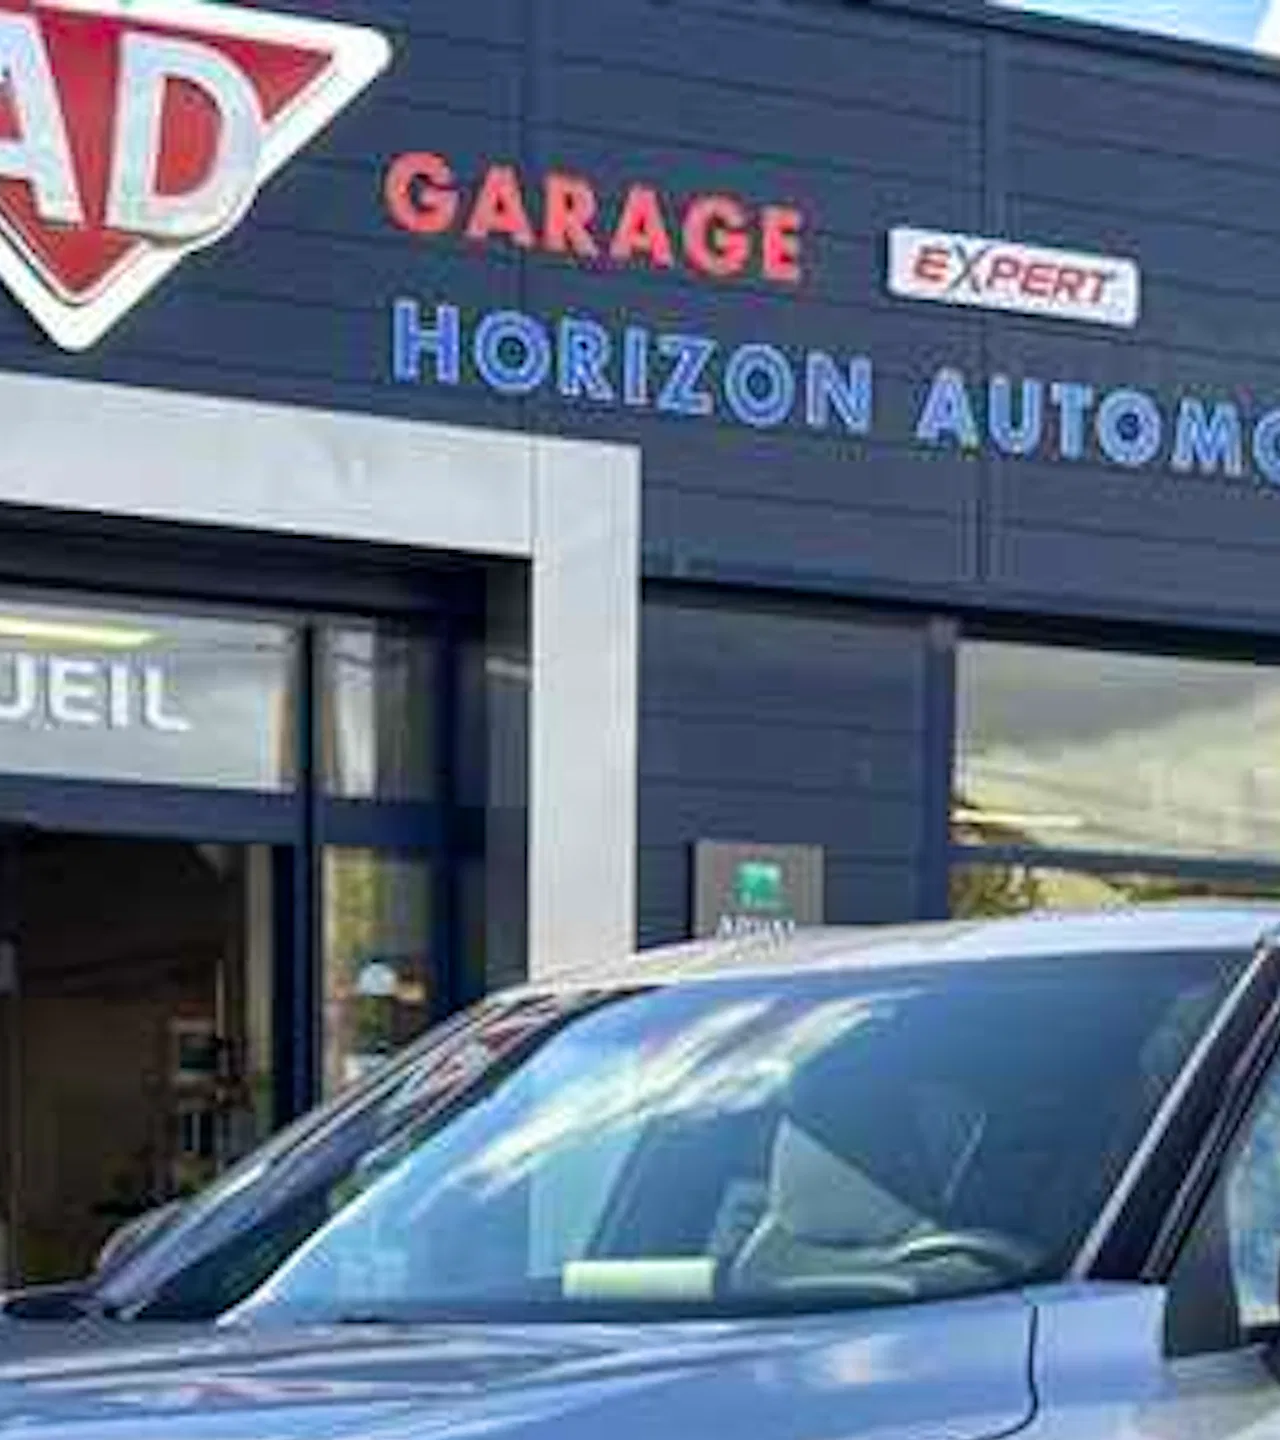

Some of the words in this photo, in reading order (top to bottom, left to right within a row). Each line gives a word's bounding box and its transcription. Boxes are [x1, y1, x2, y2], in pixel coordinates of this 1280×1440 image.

[382, 148, 802, 284] GARAGE
[913, 242, 1113, 304] EXPERT
[391, 297, 871, 435] HORIZON
